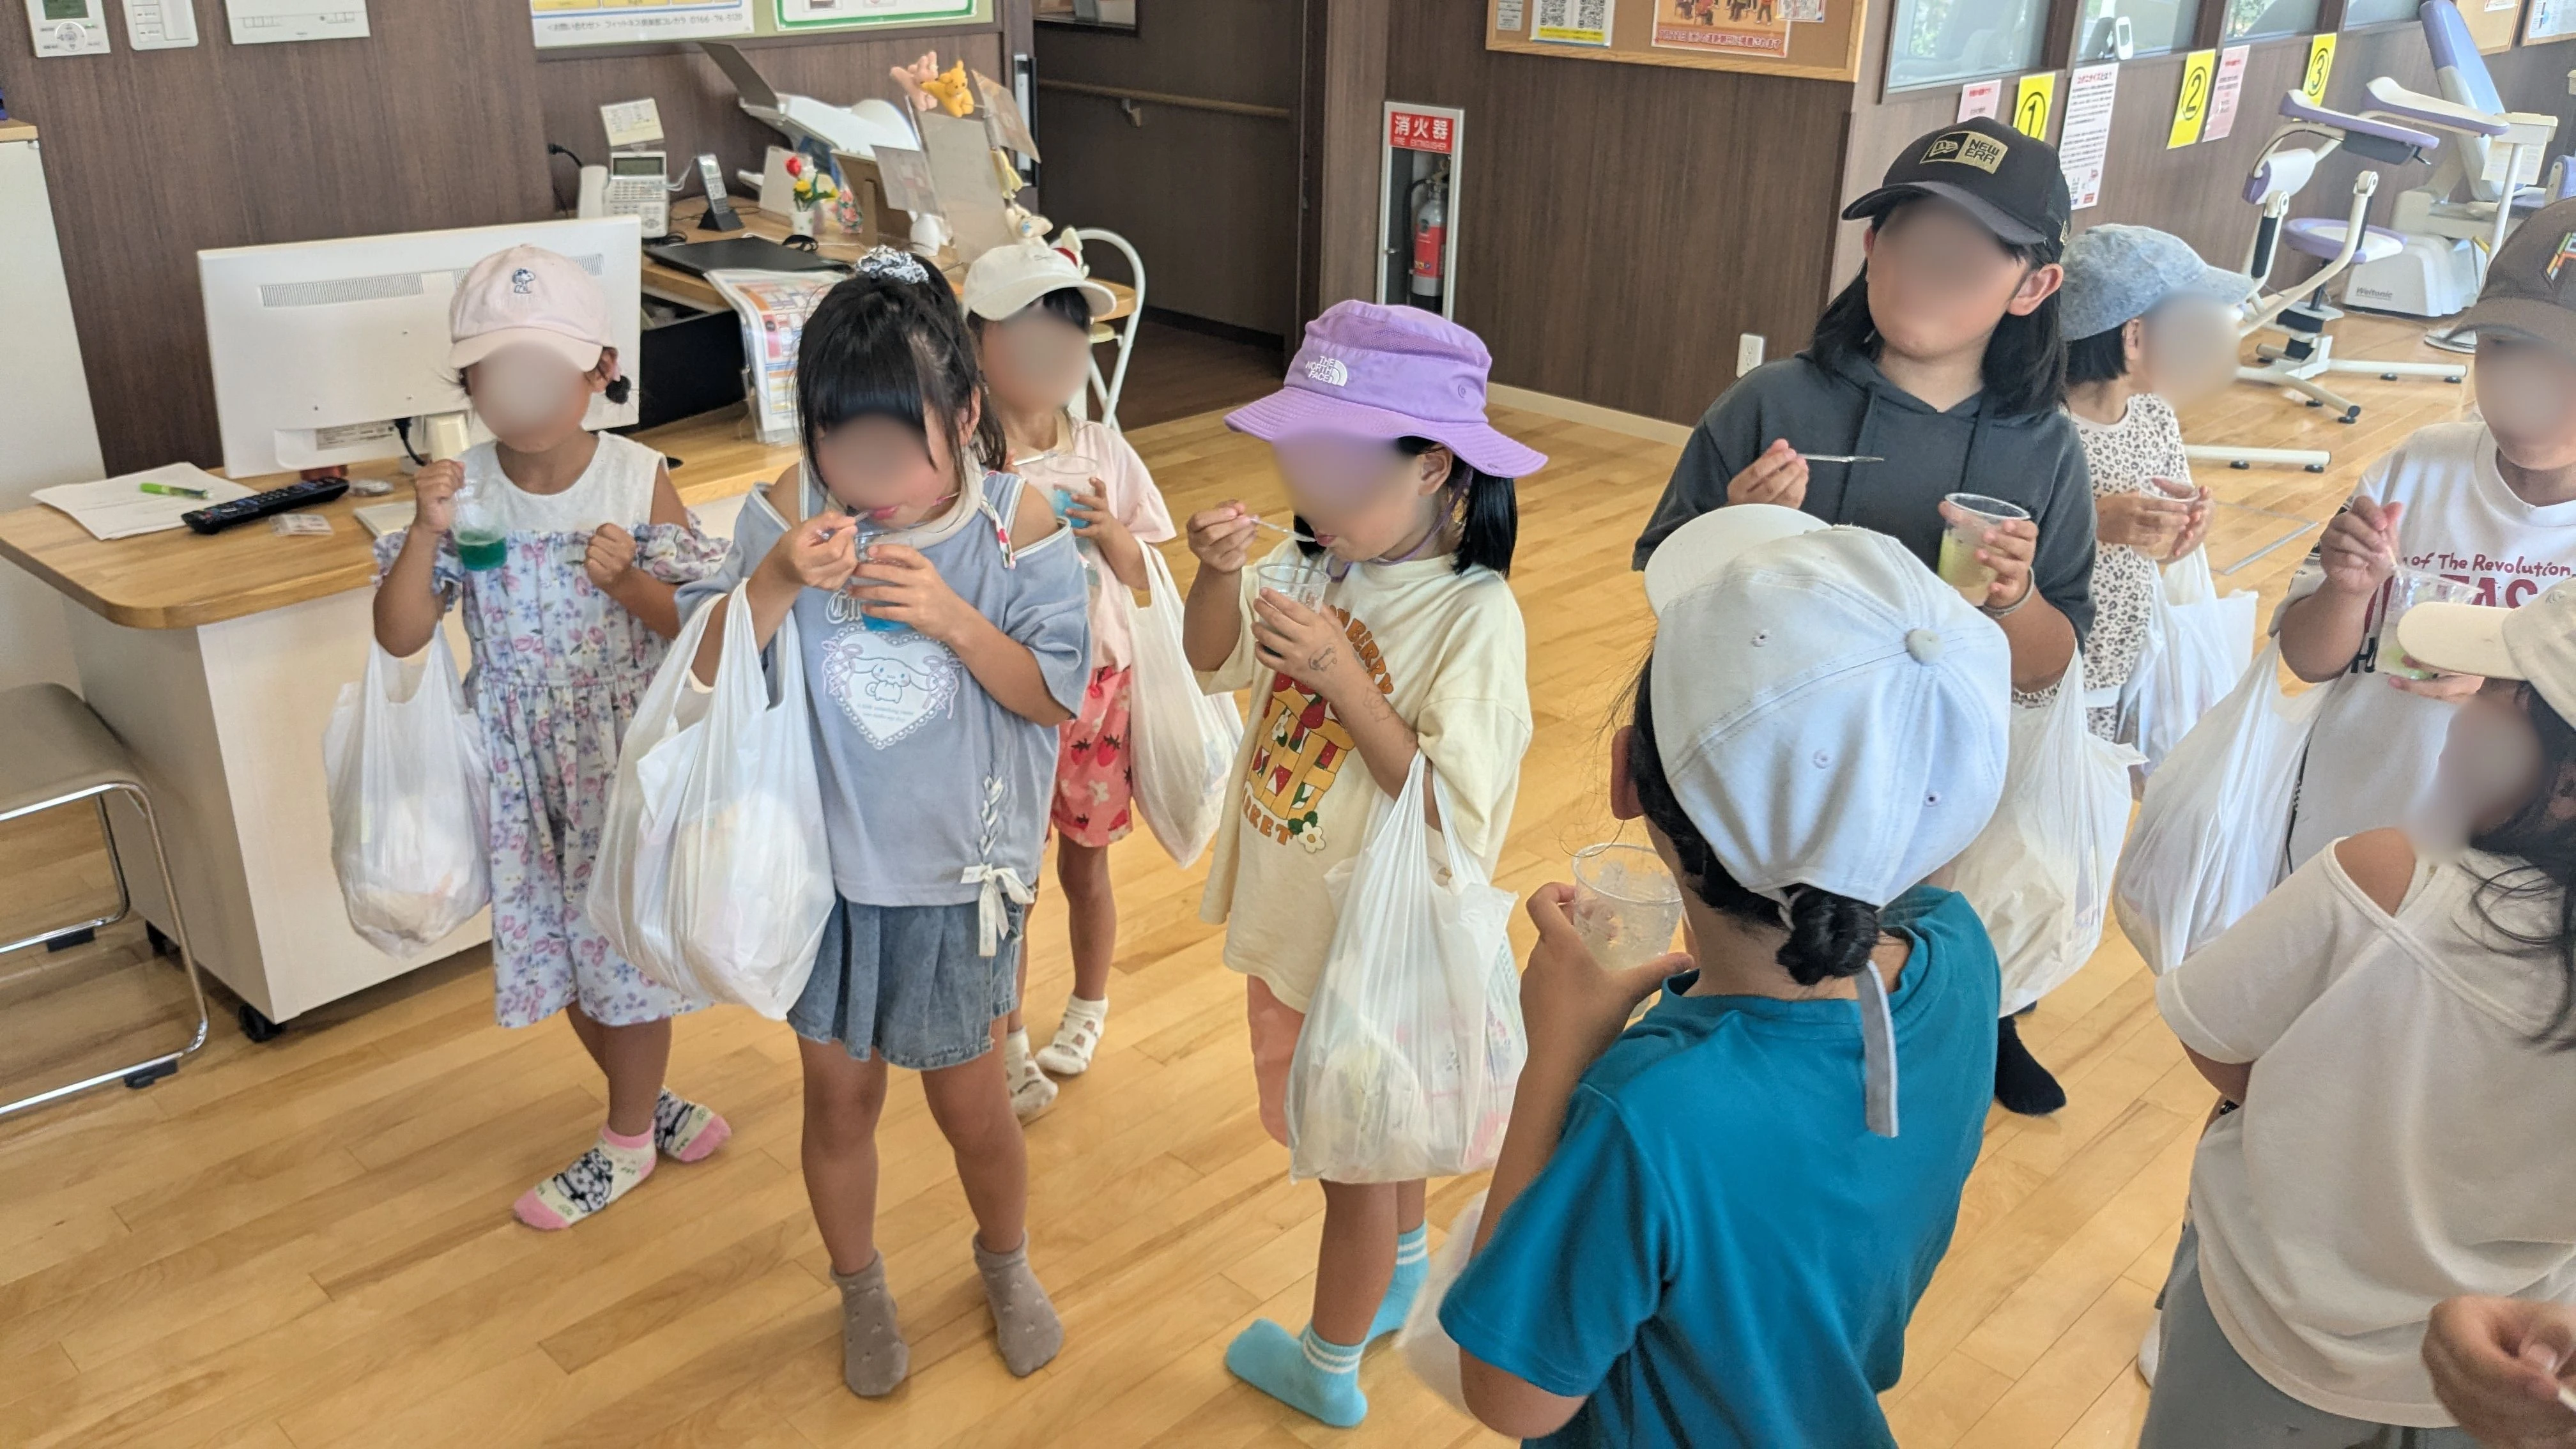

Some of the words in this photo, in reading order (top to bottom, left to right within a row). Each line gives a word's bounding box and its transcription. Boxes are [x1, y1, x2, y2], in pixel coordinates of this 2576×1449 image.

[1395, 114, 1448, 140] 消火器
[1969, 139, 2000, 156] NEW
[1965, 148, 1995, 164] ERA
[1305, 360, 1333, 374] NORTH
[1319, 355, 1336, 367] THE
[1308, 370, 1330, 382] FACE
[2411, 552, 2435, 569] of
[2438, 552, 2468, 571] The
